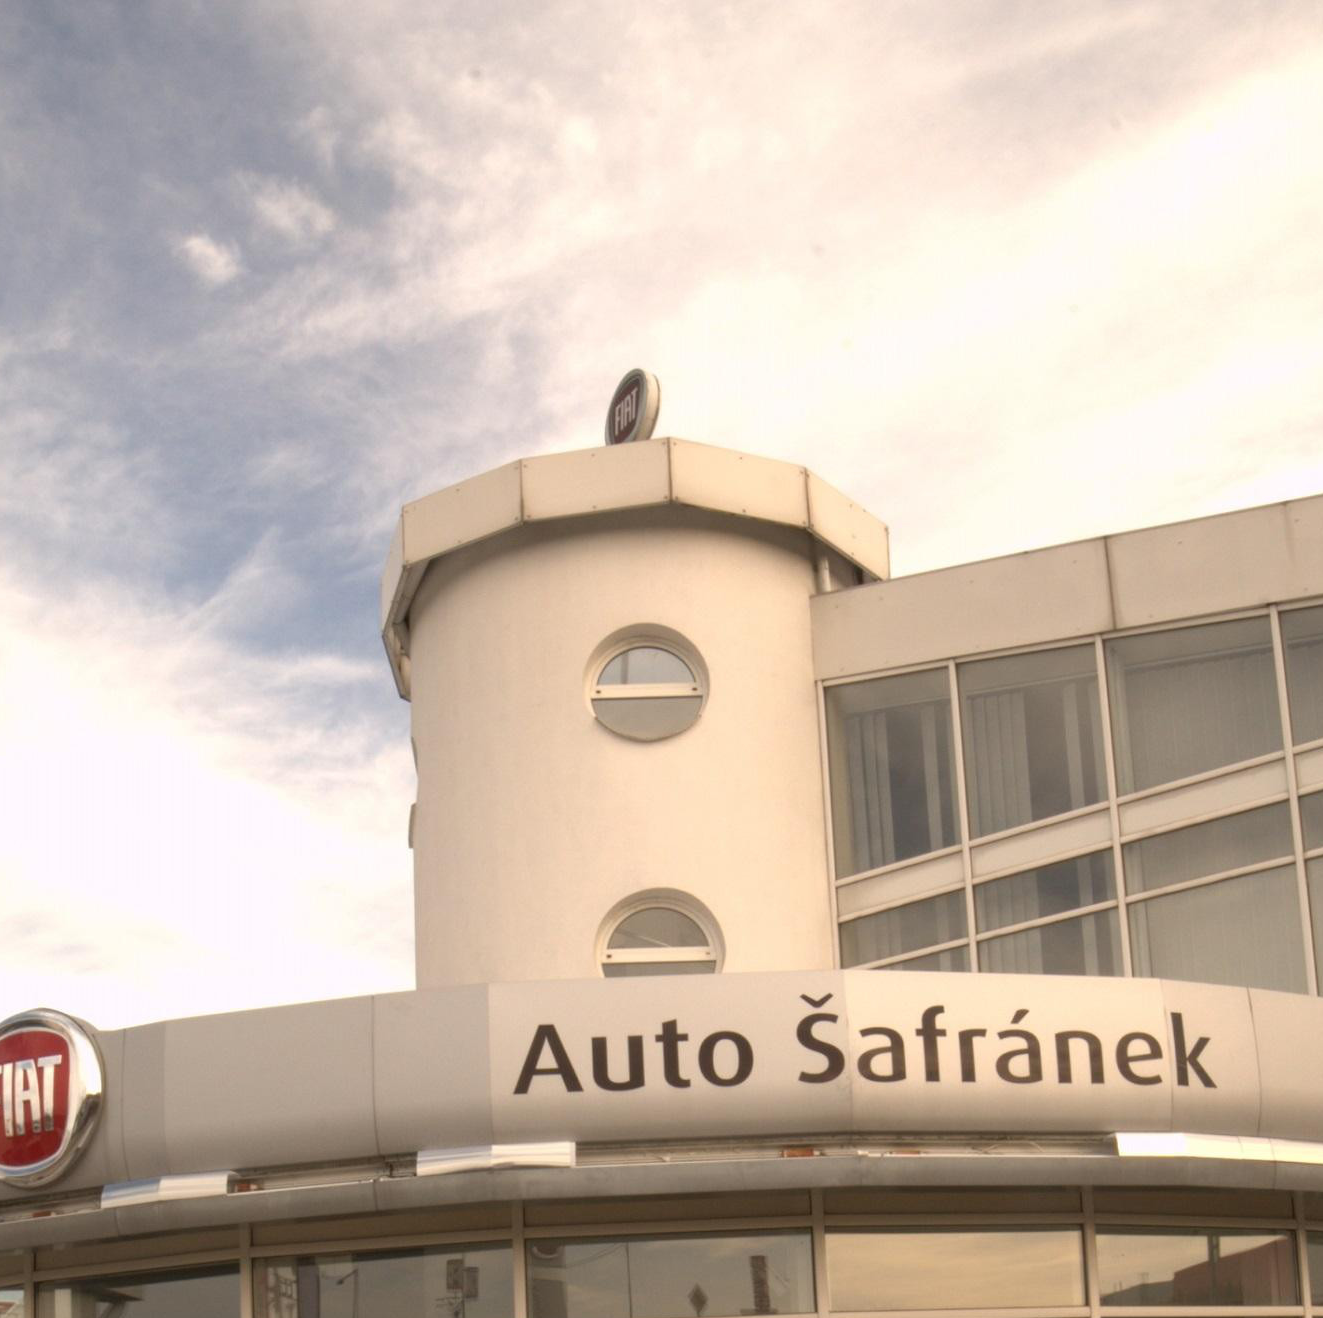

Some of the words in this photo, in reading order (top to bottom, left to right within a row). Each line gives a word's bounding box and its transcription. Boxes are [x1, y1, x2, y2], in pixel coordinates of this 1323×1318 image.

[614, 386, 638, 436] FIAT
[513, 1019, 755, 1095] Auto
[795, 993, 1218, 1089] Šafránek
